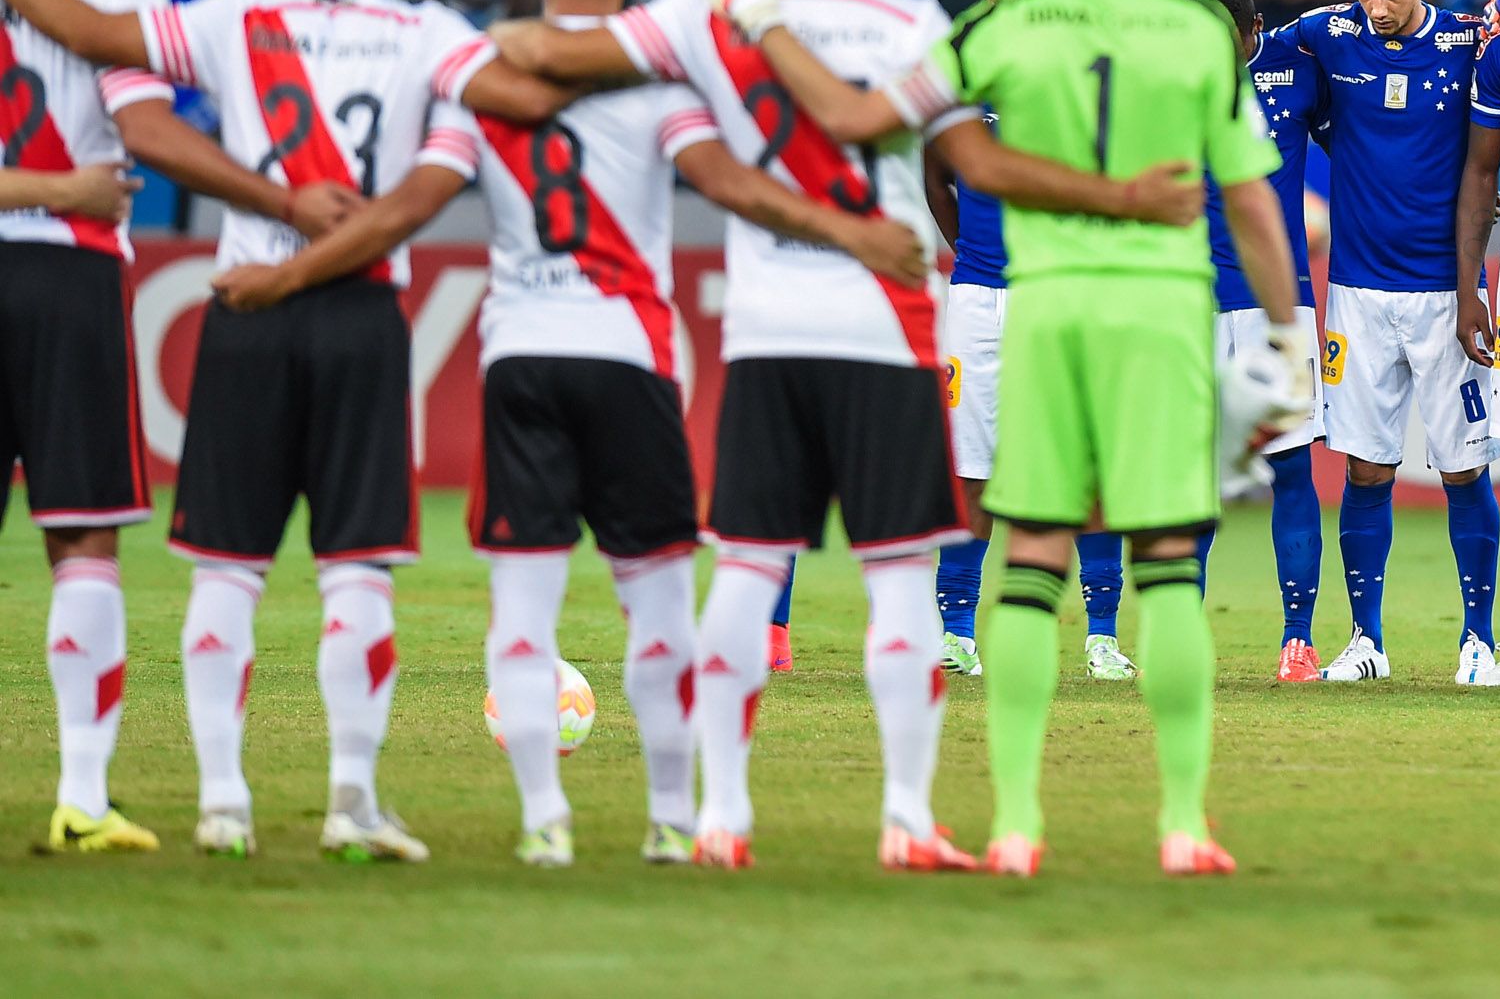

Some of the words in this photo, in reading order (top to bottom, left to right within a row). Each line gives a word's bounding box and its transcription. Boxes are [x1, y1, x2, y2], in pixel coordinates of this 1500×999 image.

[1329, 15, 1363, 36] cemil
[1434, 28, 1474, 43] cemil
[1254, 69, 1294, 83] cemil
[1331, 73, 1367, 84] PENALTY
[1087, 55, 1112, 174] 1
[532, 122, 588, 254] 8
[1459, 378, 1487, 424] 8
[1465, 434, 1492, 447] PENA
